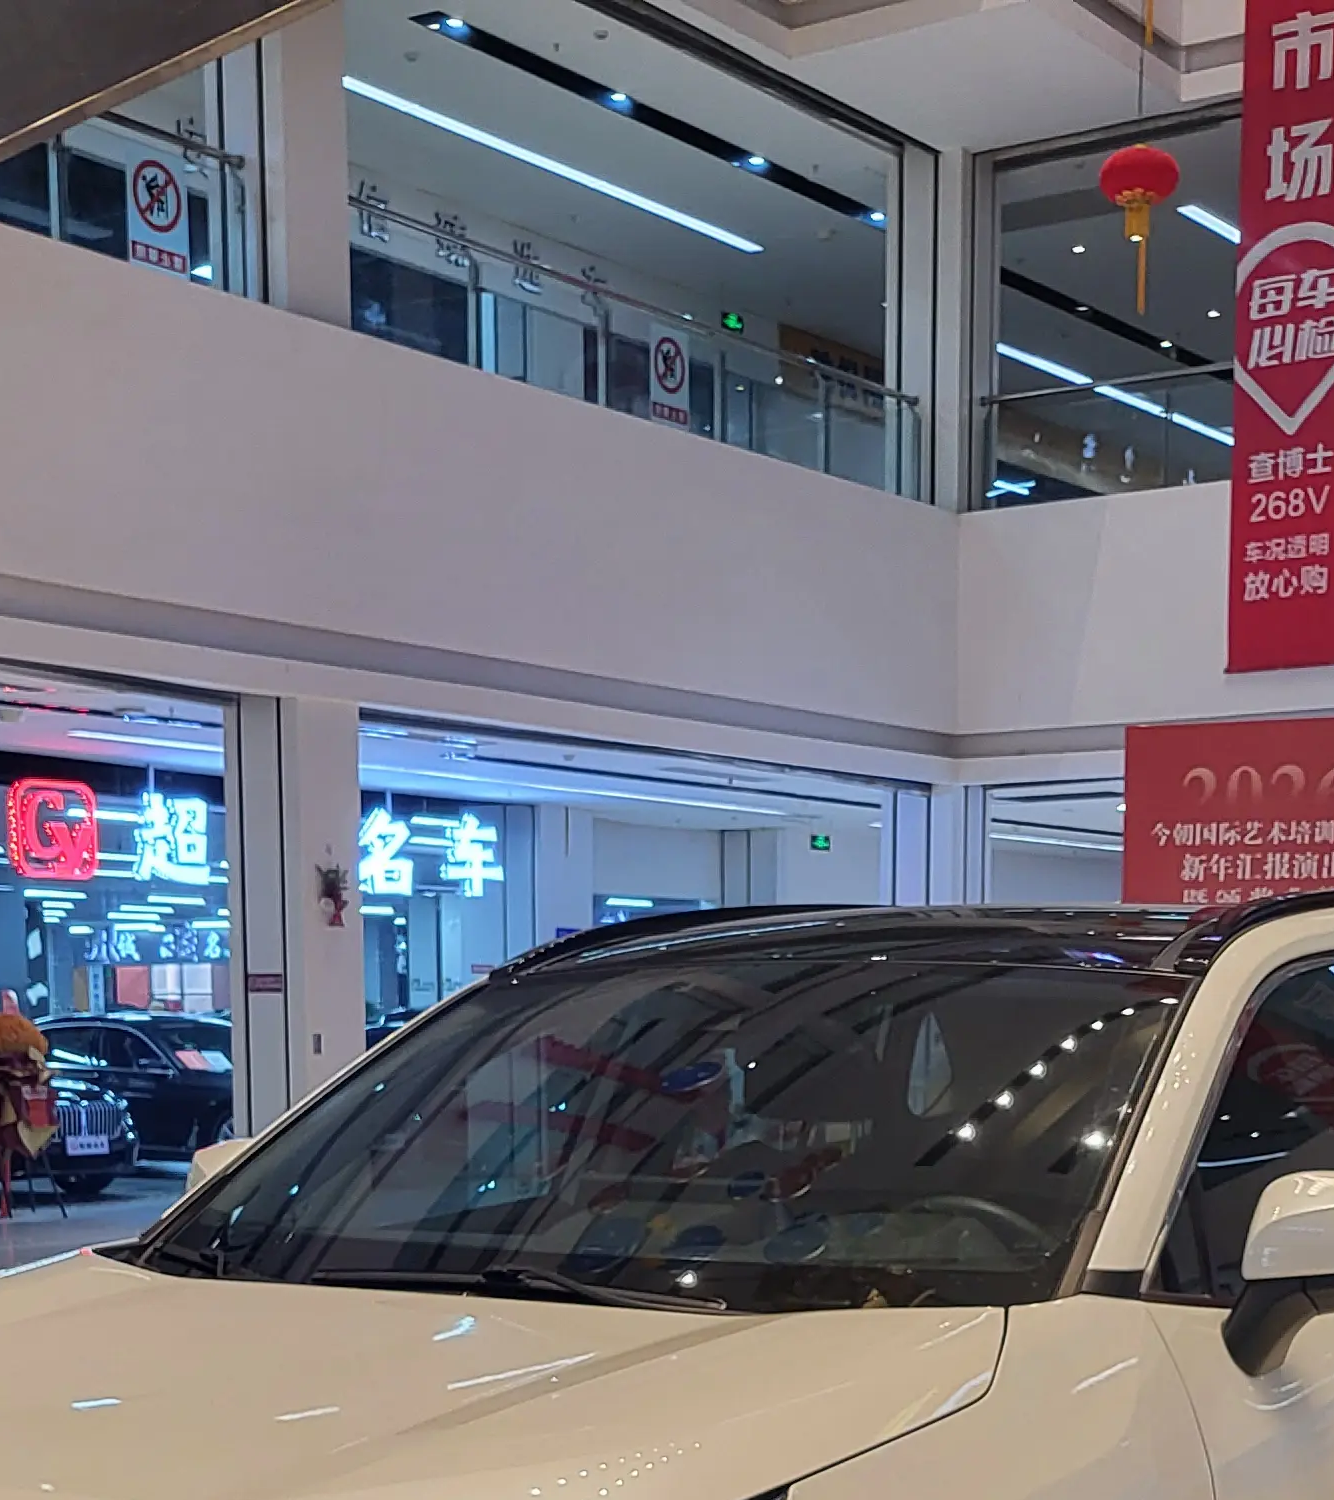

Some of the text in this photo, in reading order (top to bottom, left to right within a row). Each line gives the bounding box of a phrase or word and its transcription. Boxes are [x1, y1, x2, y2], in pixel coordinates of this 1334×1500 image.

[1247, 442, 1334, 484] 查博士
[1249, 485, 1330, 523] 268V
[1243, 532, 1330, 563] 车况透明
[1243, 564, 1329, 602] 放心购
